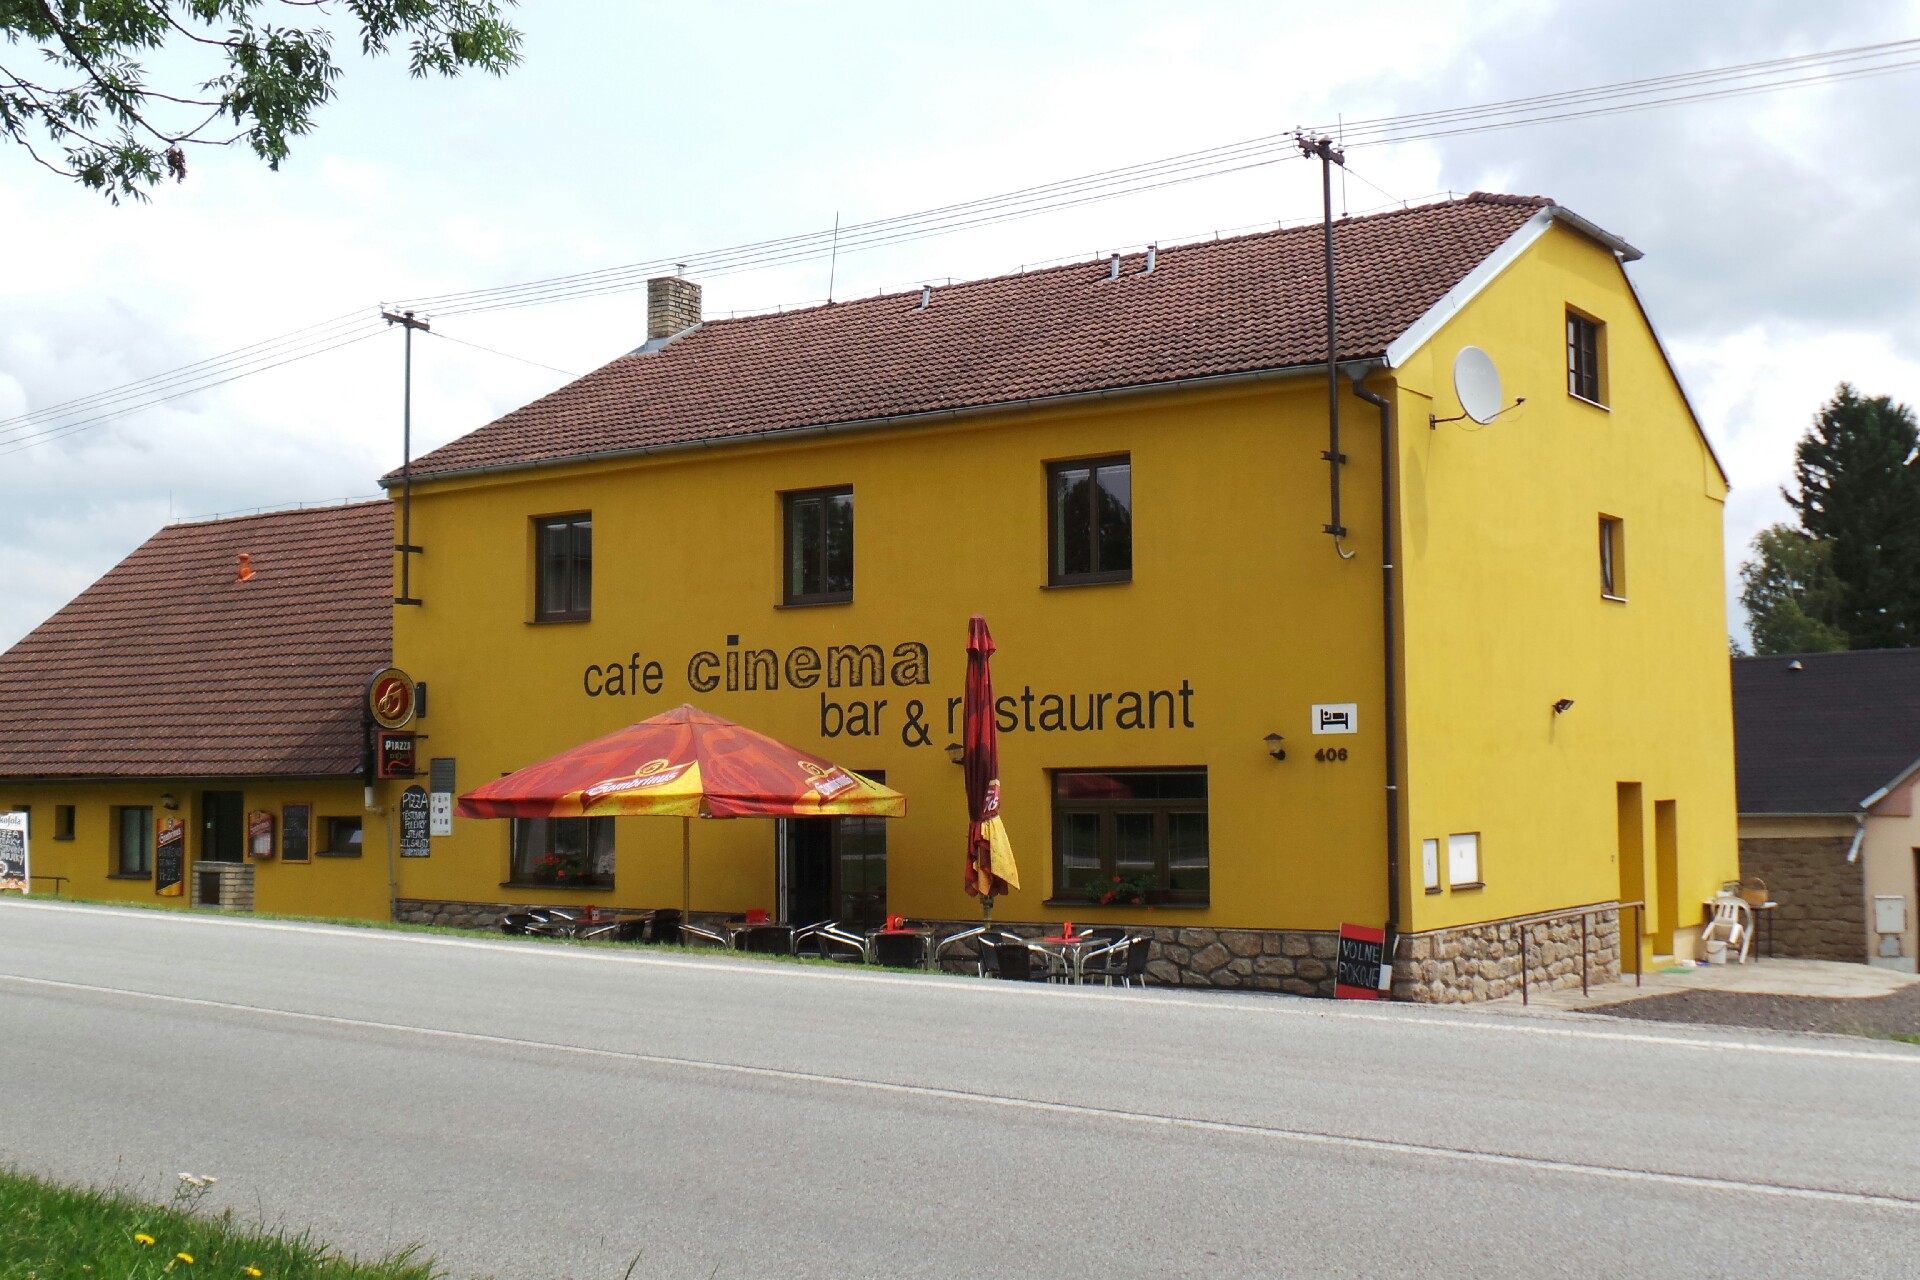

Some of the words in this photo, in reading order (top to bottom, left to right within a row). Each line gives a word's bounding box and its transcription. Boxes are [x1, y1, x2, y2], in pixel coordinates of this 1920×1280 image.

[583, 652, 664, 698] cafe
[687, 634, 931, 693] cinema
[820, 692, 888, 738] bar
[901, 699, 934, 748] &
[947, 679, 1195, 734] rstaurant
[385, 740, 411, 751] PIAZZA
[1315, 747, 1348, 762] 406
[587, 771, 680, 797] Gambrinus
[402, 792, 429, 809] PIZZA
[1340, 961, 1380, 988] POKOJE
